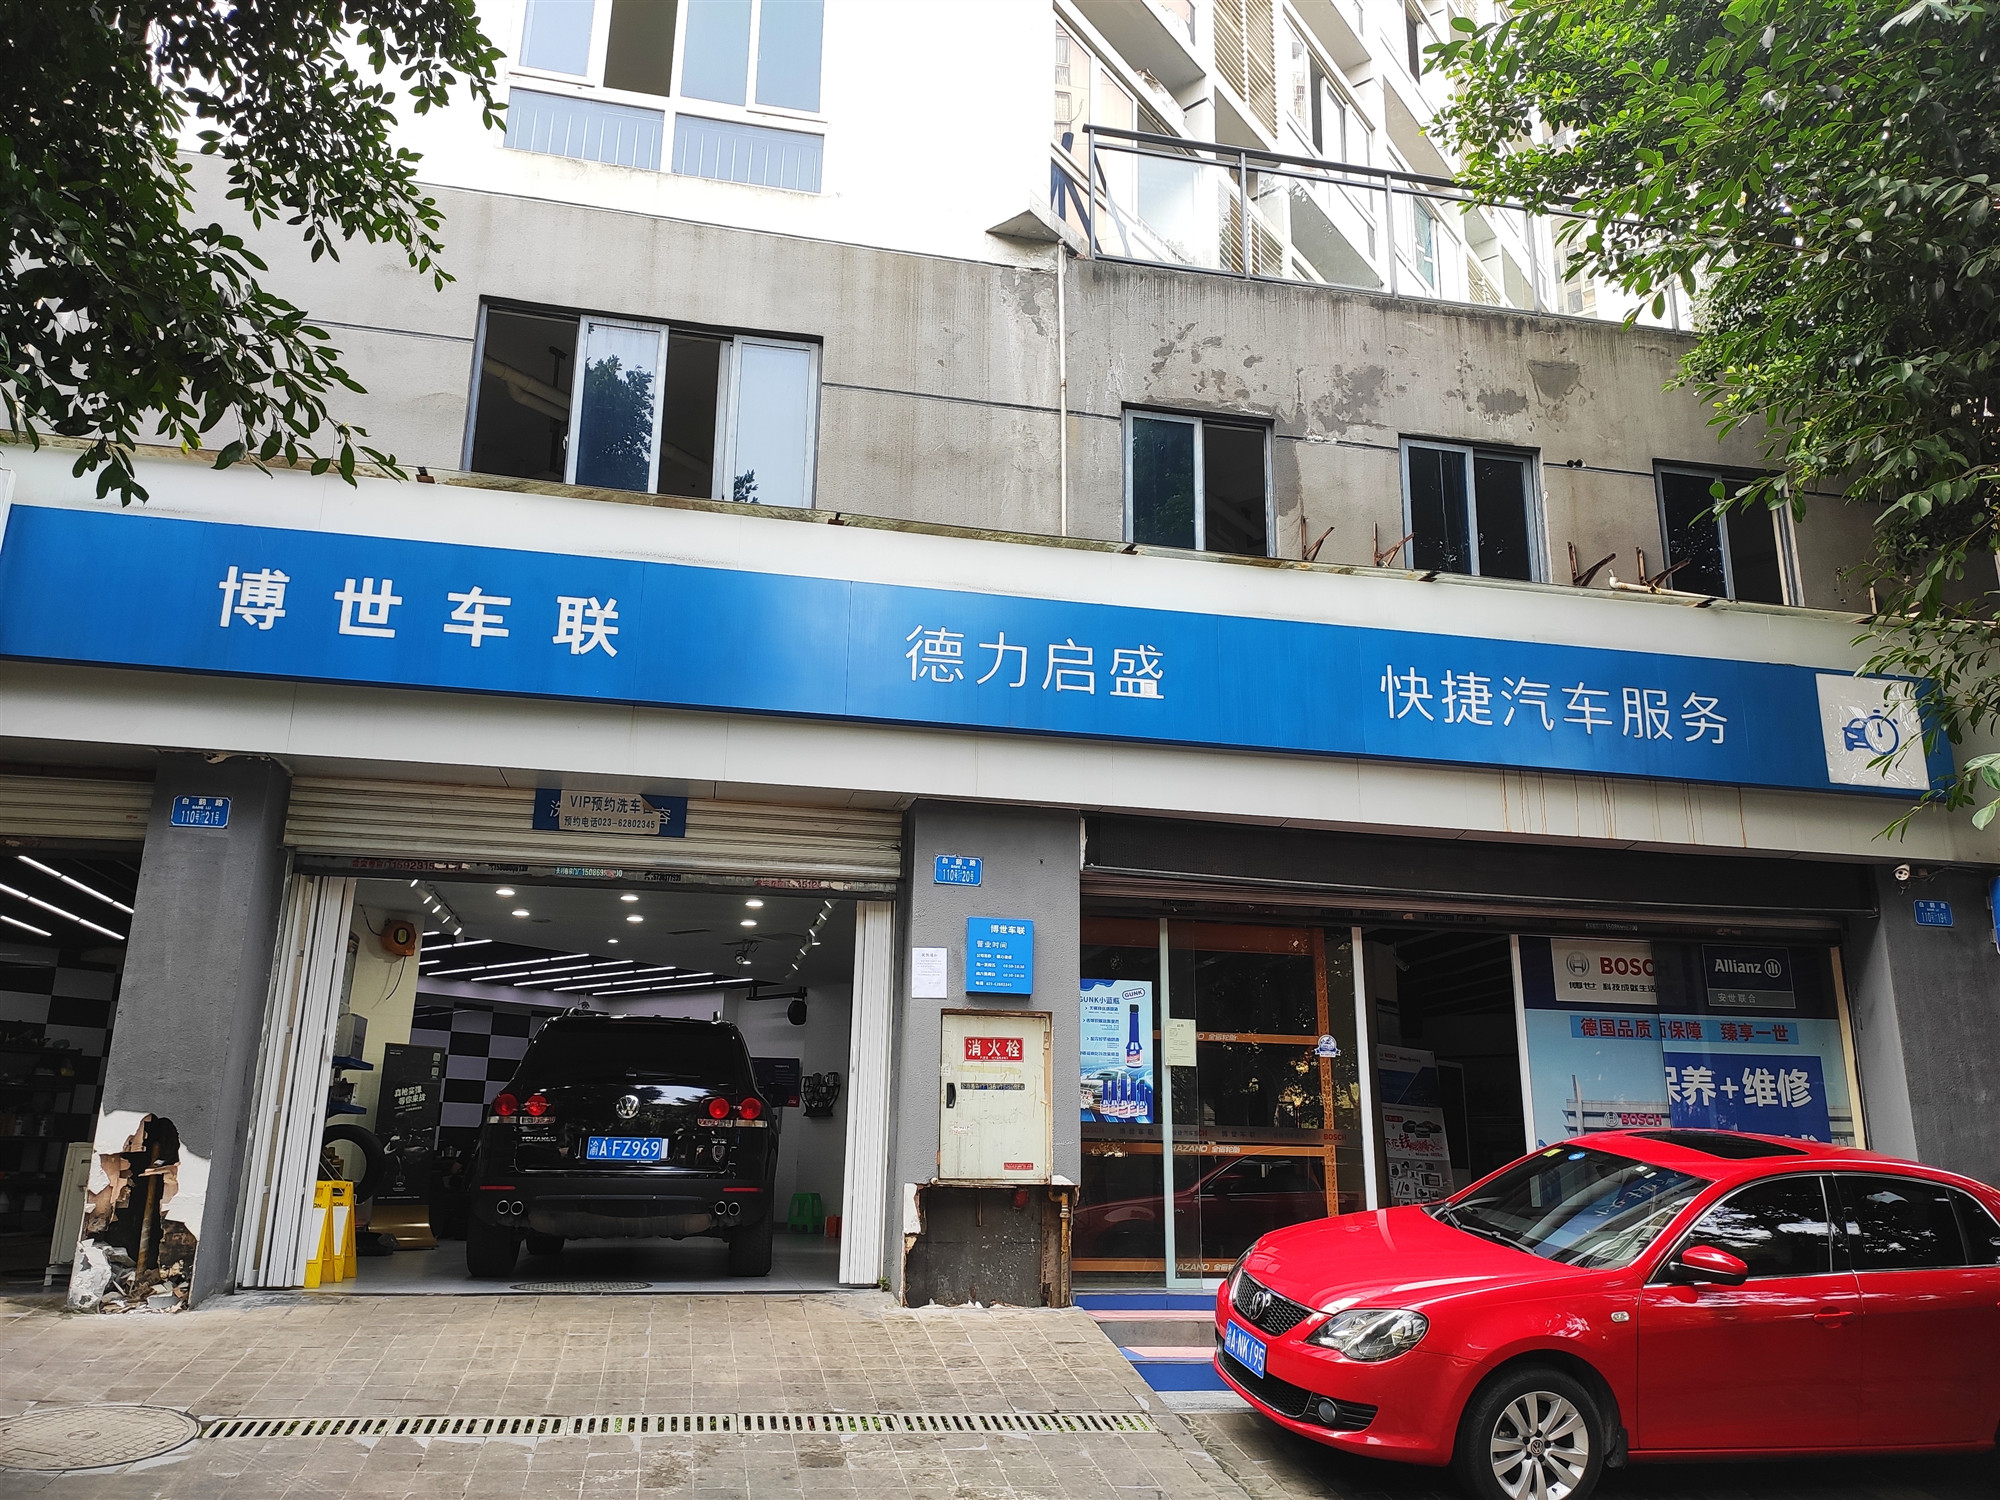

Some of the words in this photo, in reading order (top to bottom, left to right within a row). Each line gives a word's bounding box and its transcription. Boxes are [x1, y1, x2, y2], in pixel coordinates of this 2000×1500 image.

[218, 565, 620, 658] 博世车联
[905, 624, 1165, 700] 德力启盛
[1380, 664, 1728, 745] 快捷汽车服务
[990, 924, 1026, 935] 博世车联
[976, 940, 1008, 949] 营业时间
[1600, 957, 1657, 977] BOSC
[1715, 959, 1762, 975] Allianz
[1124, 989, 1143, 997] GUNK
[1718, 993, 1757, 1004] 安世联合
[1720, 1021, 1789, 1042] 臻享一世
[968, 1039, 1020, 1057] 消火栓
[1620, 1113, 1662, 1126] BOSCH
